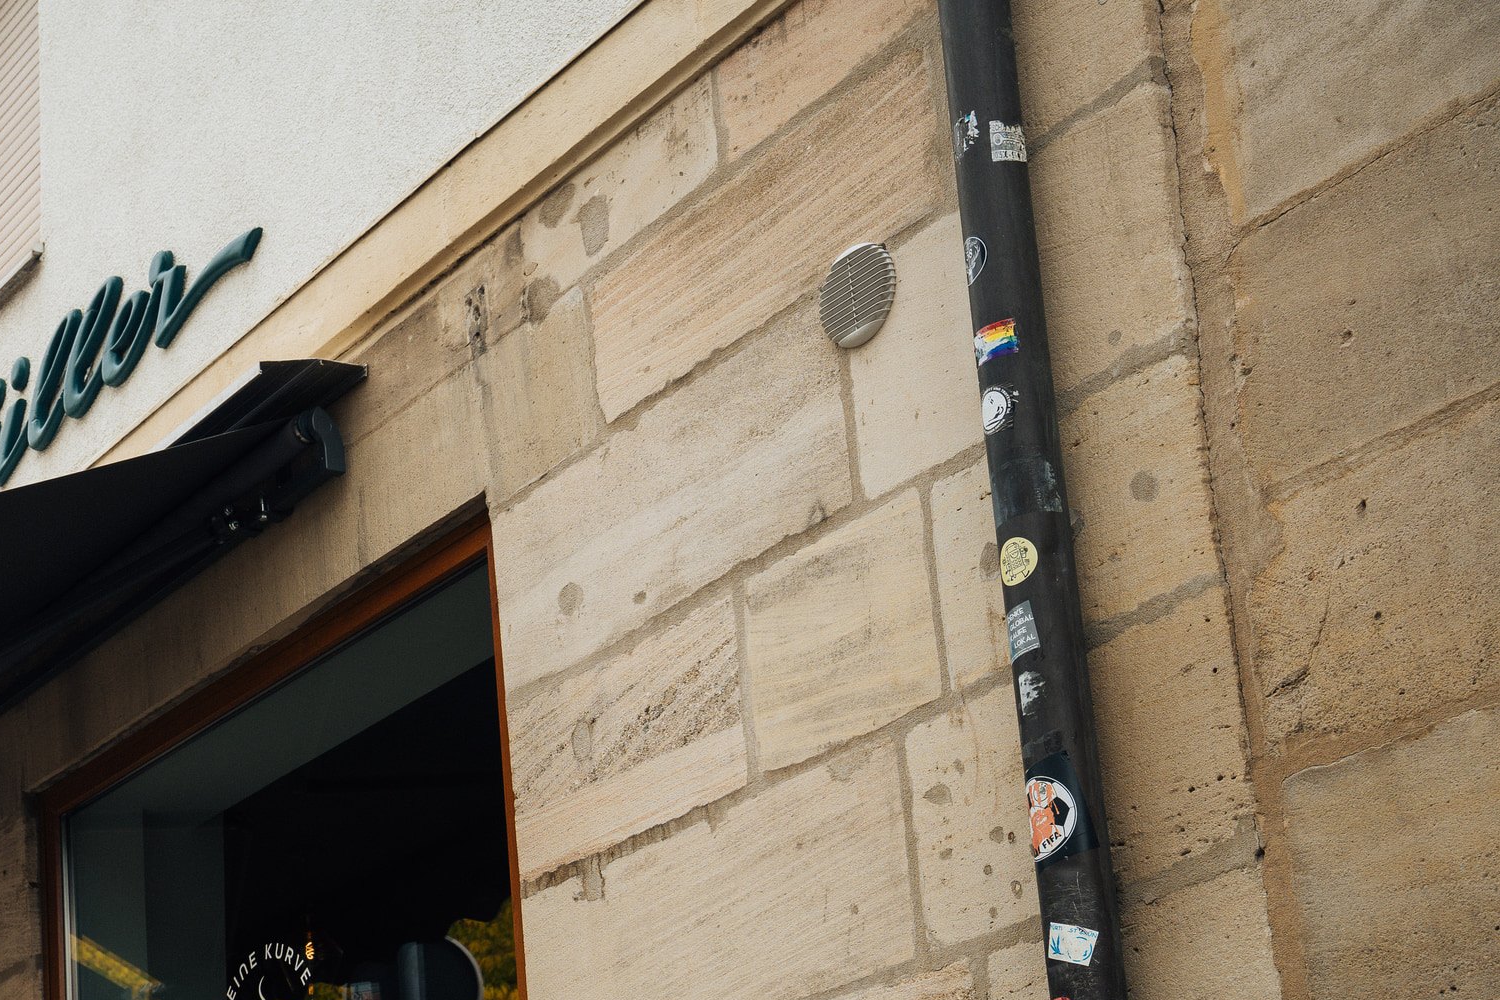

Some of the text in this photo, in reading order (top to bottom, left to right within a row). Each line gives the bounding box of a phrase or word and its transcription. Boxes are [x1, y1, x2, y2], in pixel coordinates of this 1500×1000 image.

[1010, 614, 1034, 631] GLOBAL
[1014, 634, 1036, 648] LOKAL
[1041, 831, 1062, 849] FIFA
[264, 942, 312, 986] KURVE
